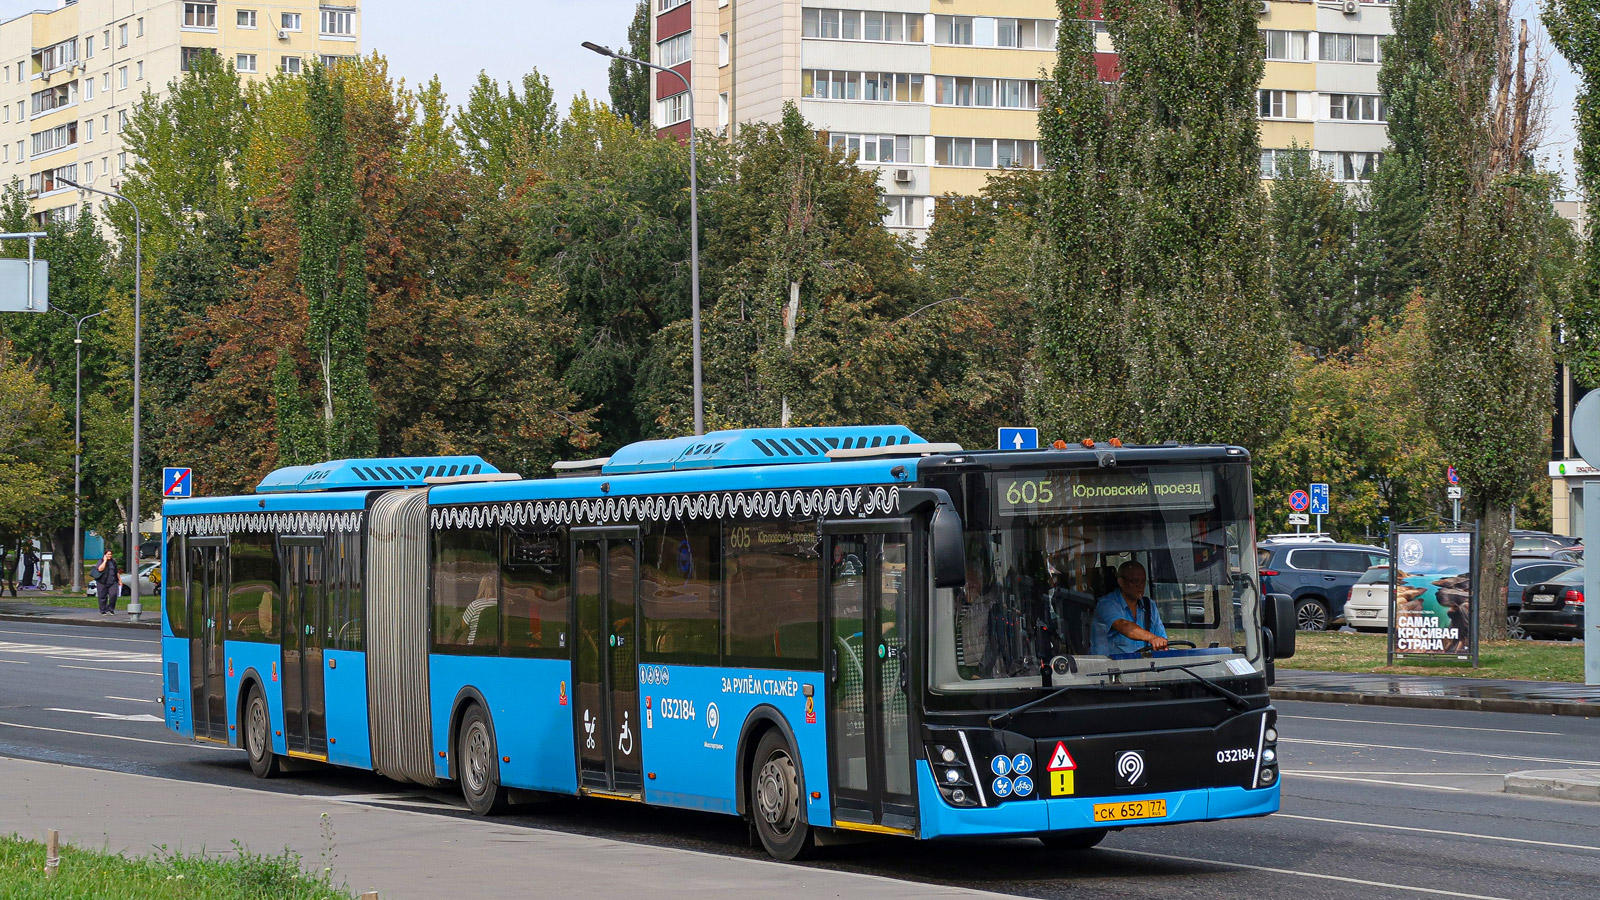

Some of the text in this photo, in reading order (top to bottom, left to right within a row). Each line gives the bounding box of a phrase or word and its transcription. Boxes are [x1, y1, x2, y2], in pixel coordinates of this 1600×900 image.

[1006, 481, 1202, 504] 605 Юрловский проезд
[730, 526, 751, 548] 605
[1398, 616, 1439, 628] САМАЯ
[1397, 627, 1459, 639] КРАСИВАЯ
[1397, 638, 1444, 650] СТРАНА
[721, 675, 799, 697] ЗА РУЛЁМ СТАЖЁР
[660, 697, 696, 721] 032184
[1216, 748, 1255, 763] 032184
[1100, 801, 1162, 819] СК 652 77
